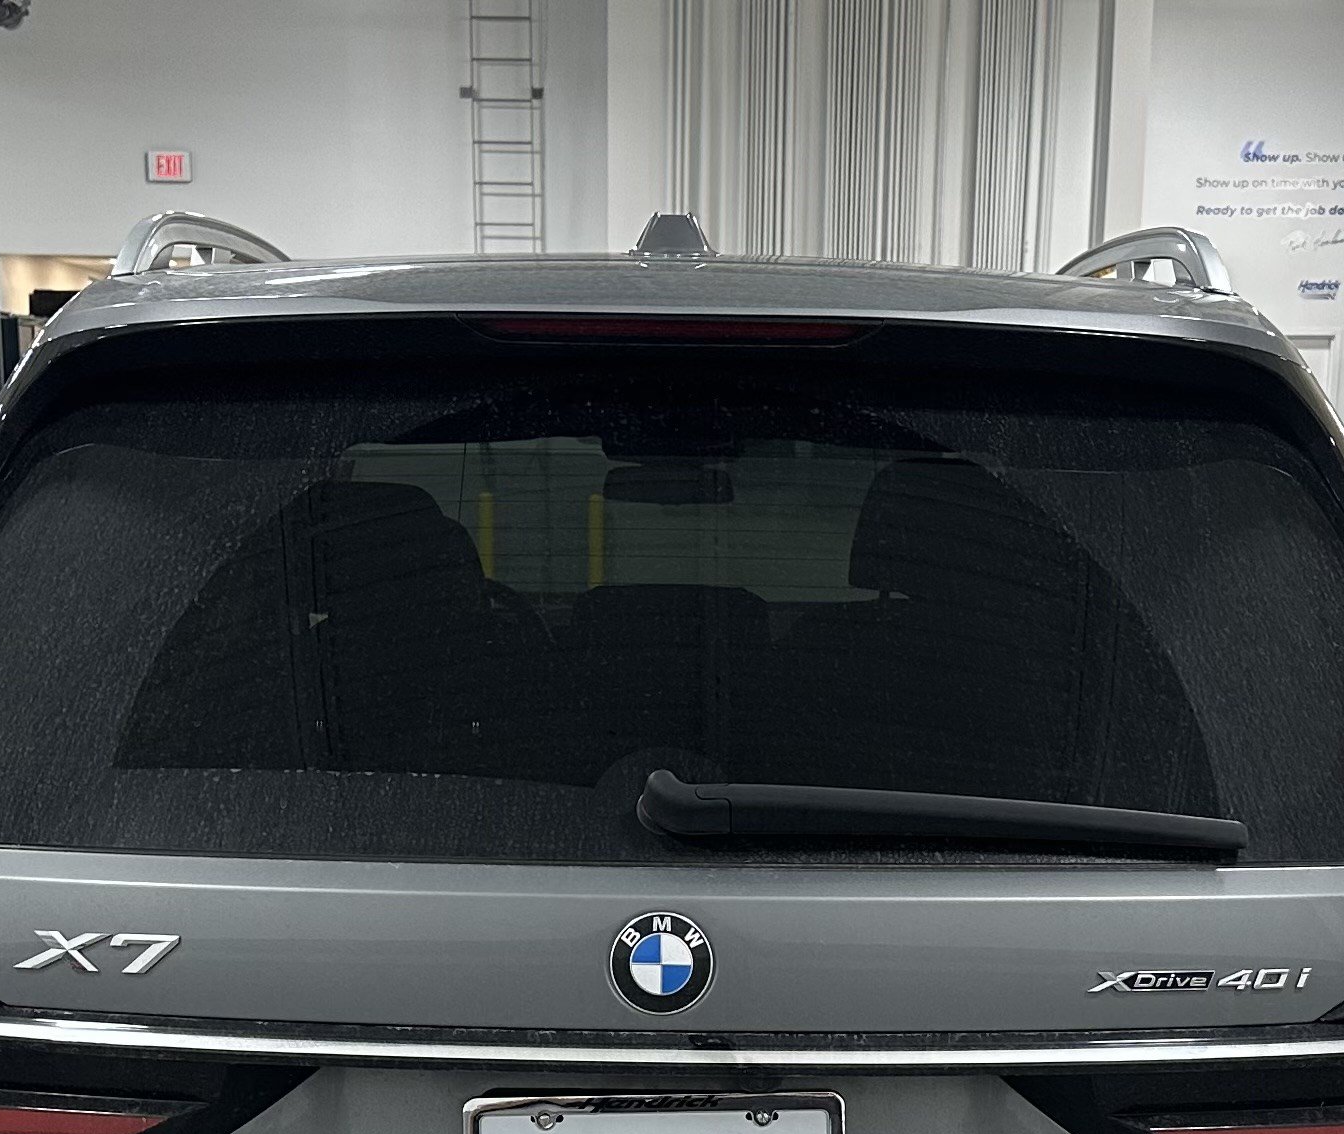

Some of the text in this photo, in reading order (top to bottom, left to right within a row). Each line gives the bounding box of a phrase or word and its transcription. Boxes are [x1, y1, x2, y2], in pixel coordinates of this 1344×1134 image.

[1282, 154, 1302, 166] up.
[1305, 152, 1340, 164] Show
[1195, 178, 1231, 189] Show
[1232, 180, 1250, 191] up
[1252, 179, 1268, 189] on
[1271, 178, 1299, 189] time
[1196, 205, 1238, 217] Ready
[1240, 205, 1253, 215] to
[1256, 205, 1278, 218] get
[1281, 205, 1302, 215] the
[1304, 205, 1326, 218] job
[13, 930, 182, 974] X7
